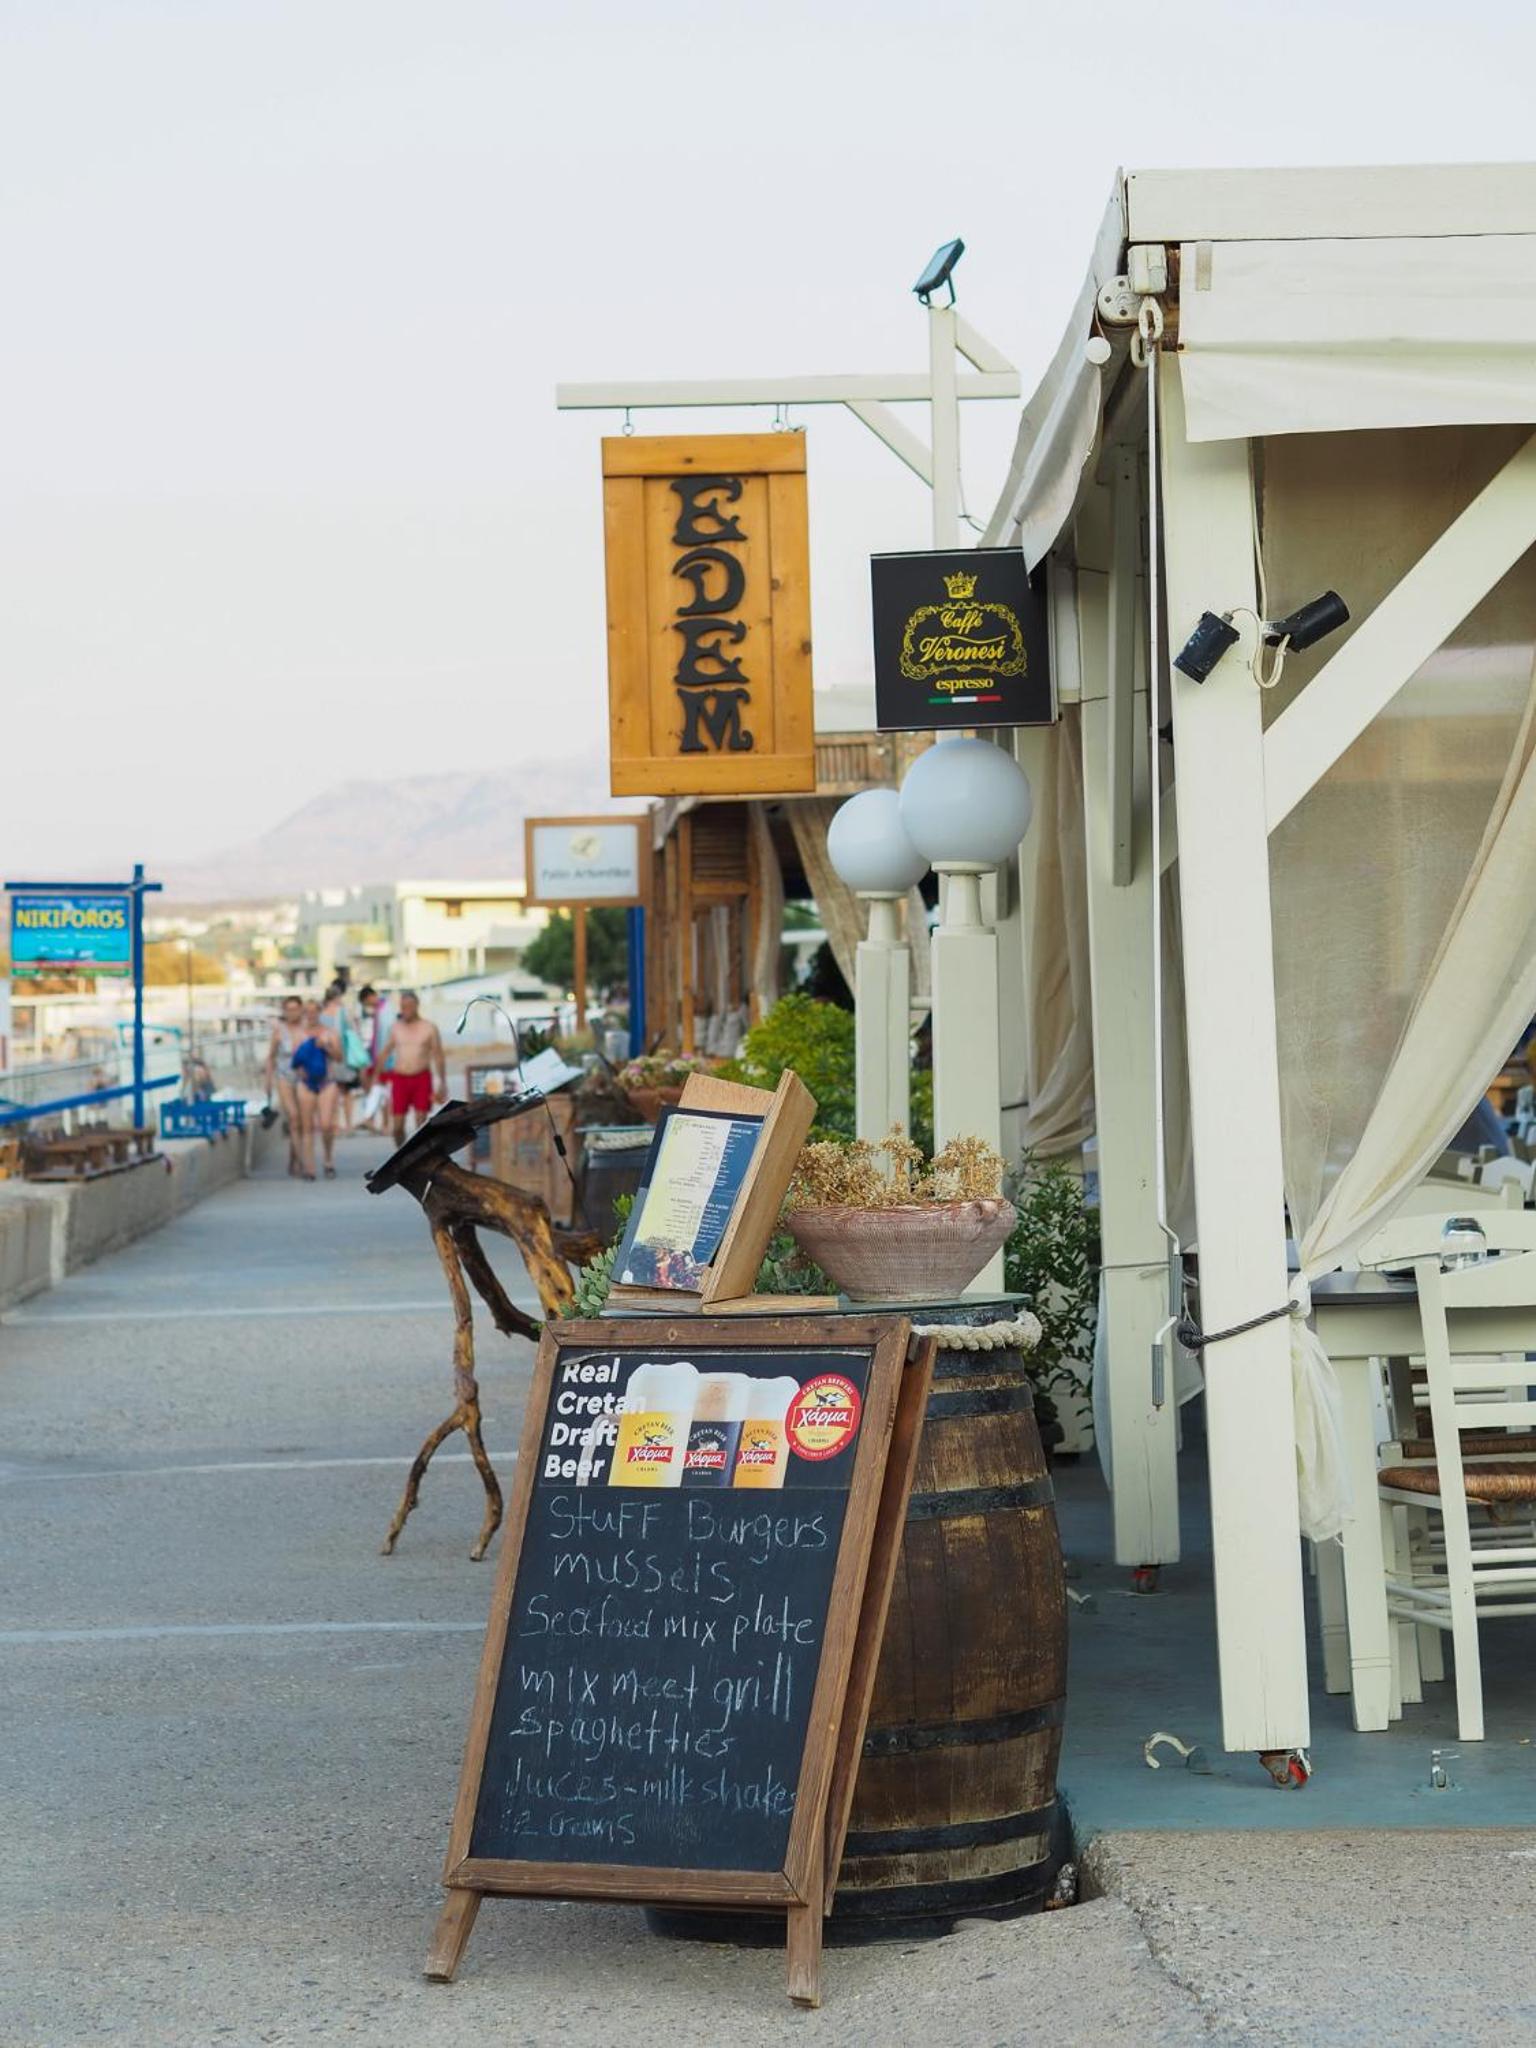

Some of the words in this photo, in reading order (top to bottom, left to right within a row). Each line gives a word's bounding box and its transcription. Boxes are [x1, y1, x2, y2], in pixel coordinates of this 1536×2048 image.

[670, 474, 754, 753] EDEM
[919, 634, 1007, 663] Veronesi
[935, 677, 994, 694] espresso
[16, 909, 125, 928] NIKIFOROS
[562, 1357, 620, 1384] Real
[556, 1390, 647, 1416] Cretan
[550, 1421, 620, 1447] Draft
[544, 1453, 606, 1479] Beer
[688, 1500, 828, 1564] Burgers
[664, 1611, 717, 1647] mix
[732, 1593, 816, 1653] plate
[713, 1651, 792, 1734] grill
